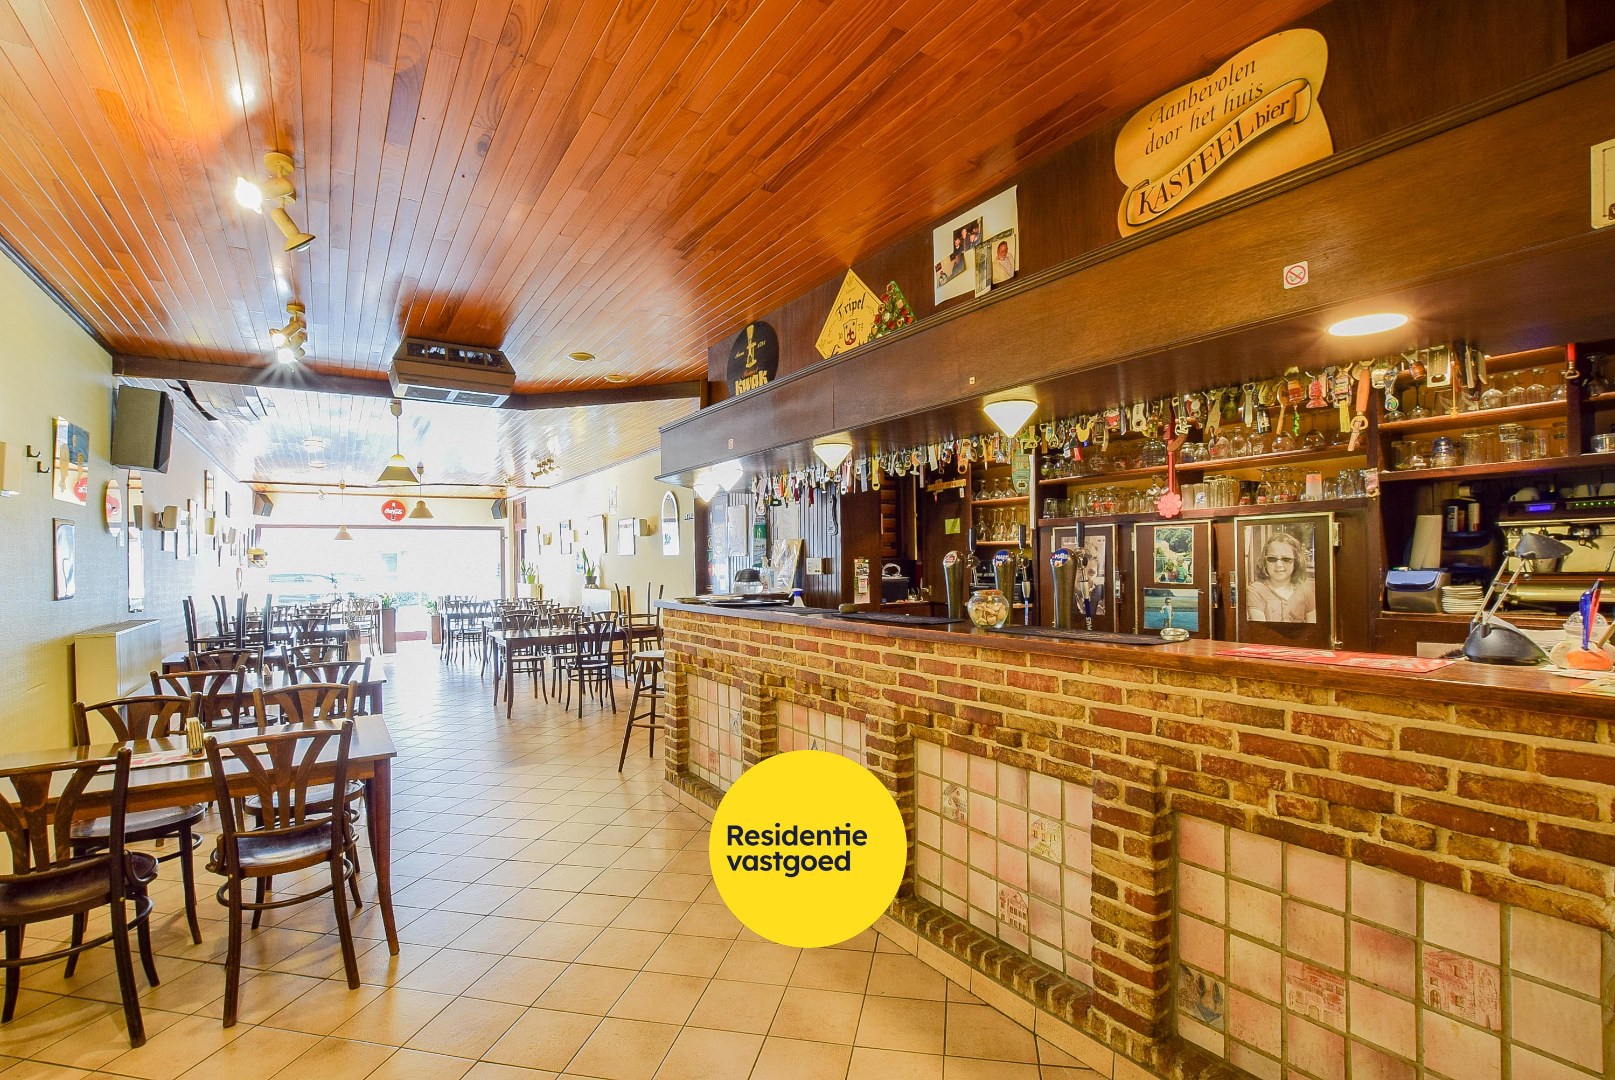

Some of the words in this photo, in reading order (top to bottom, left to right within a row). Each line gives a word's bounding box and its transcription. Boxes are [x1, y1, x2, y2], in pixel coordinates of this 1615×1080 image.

[1145, 125, 1183, 155] door
[1189, 104, 1216, 133] het
[1223, 82, 1264, 115] huis
[1148, 60, 1256, 130] Aanbevolen
[836, 291, 867, 318] Tripel
